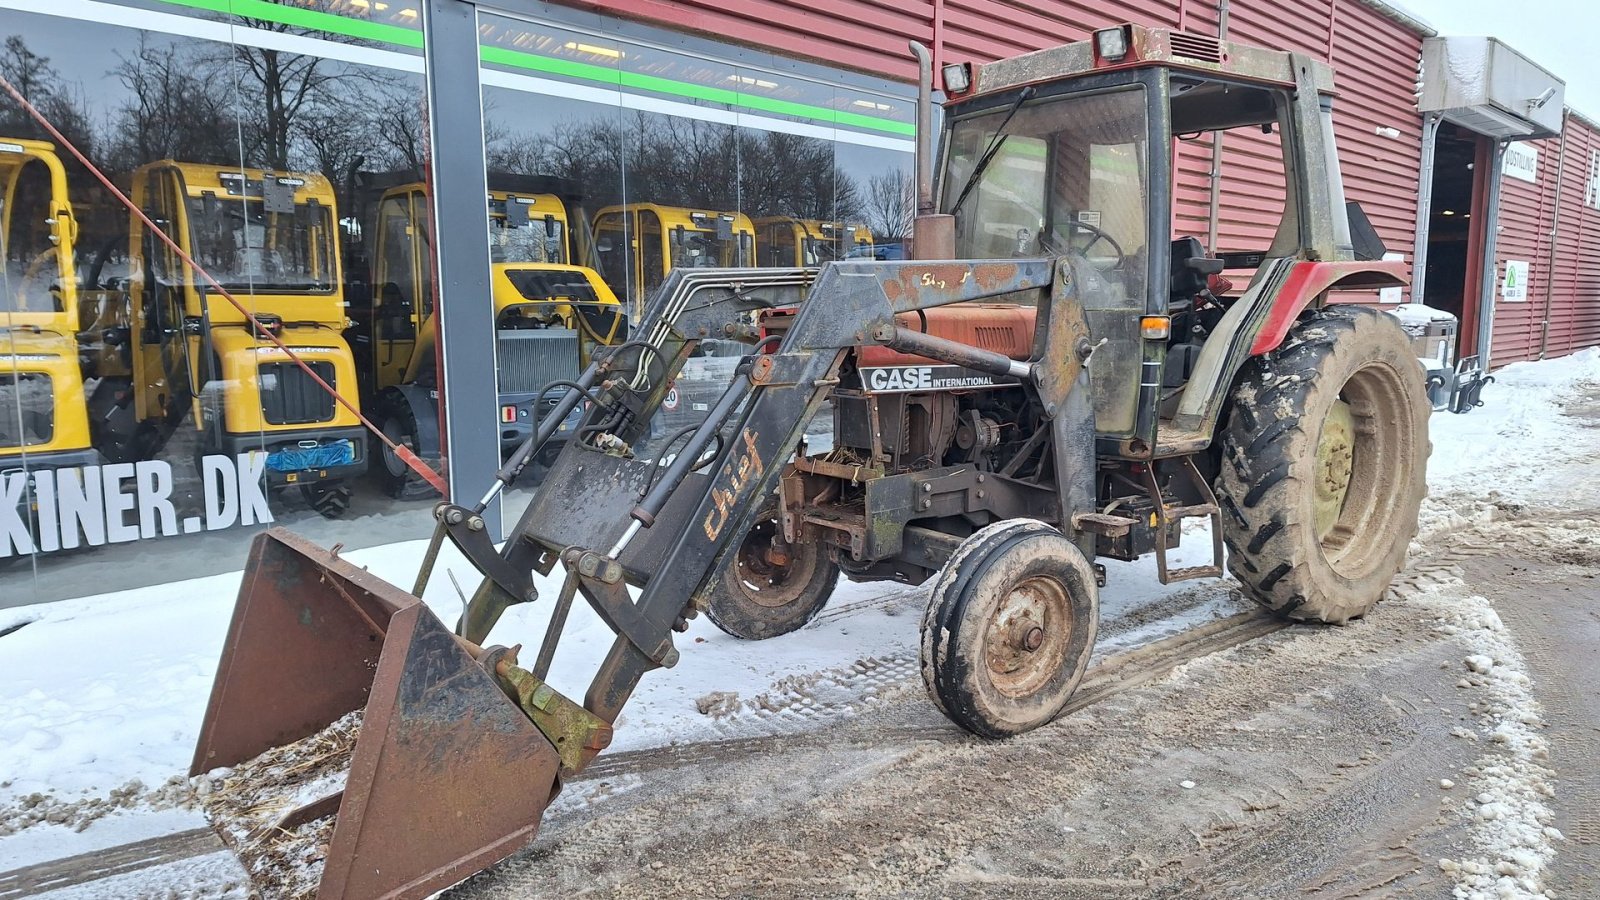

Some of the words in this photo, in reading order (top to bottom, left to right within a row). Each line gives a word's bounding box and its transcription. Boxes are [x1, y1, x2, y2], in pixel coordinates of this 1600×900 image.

[1505, 148, 1535, 173] UDSTILLING
[870, 368, 932, 389] CASE
[933, 376, 993, 388] INTERNATIONAL
[0, 451, 275, 558] KINER.DK
